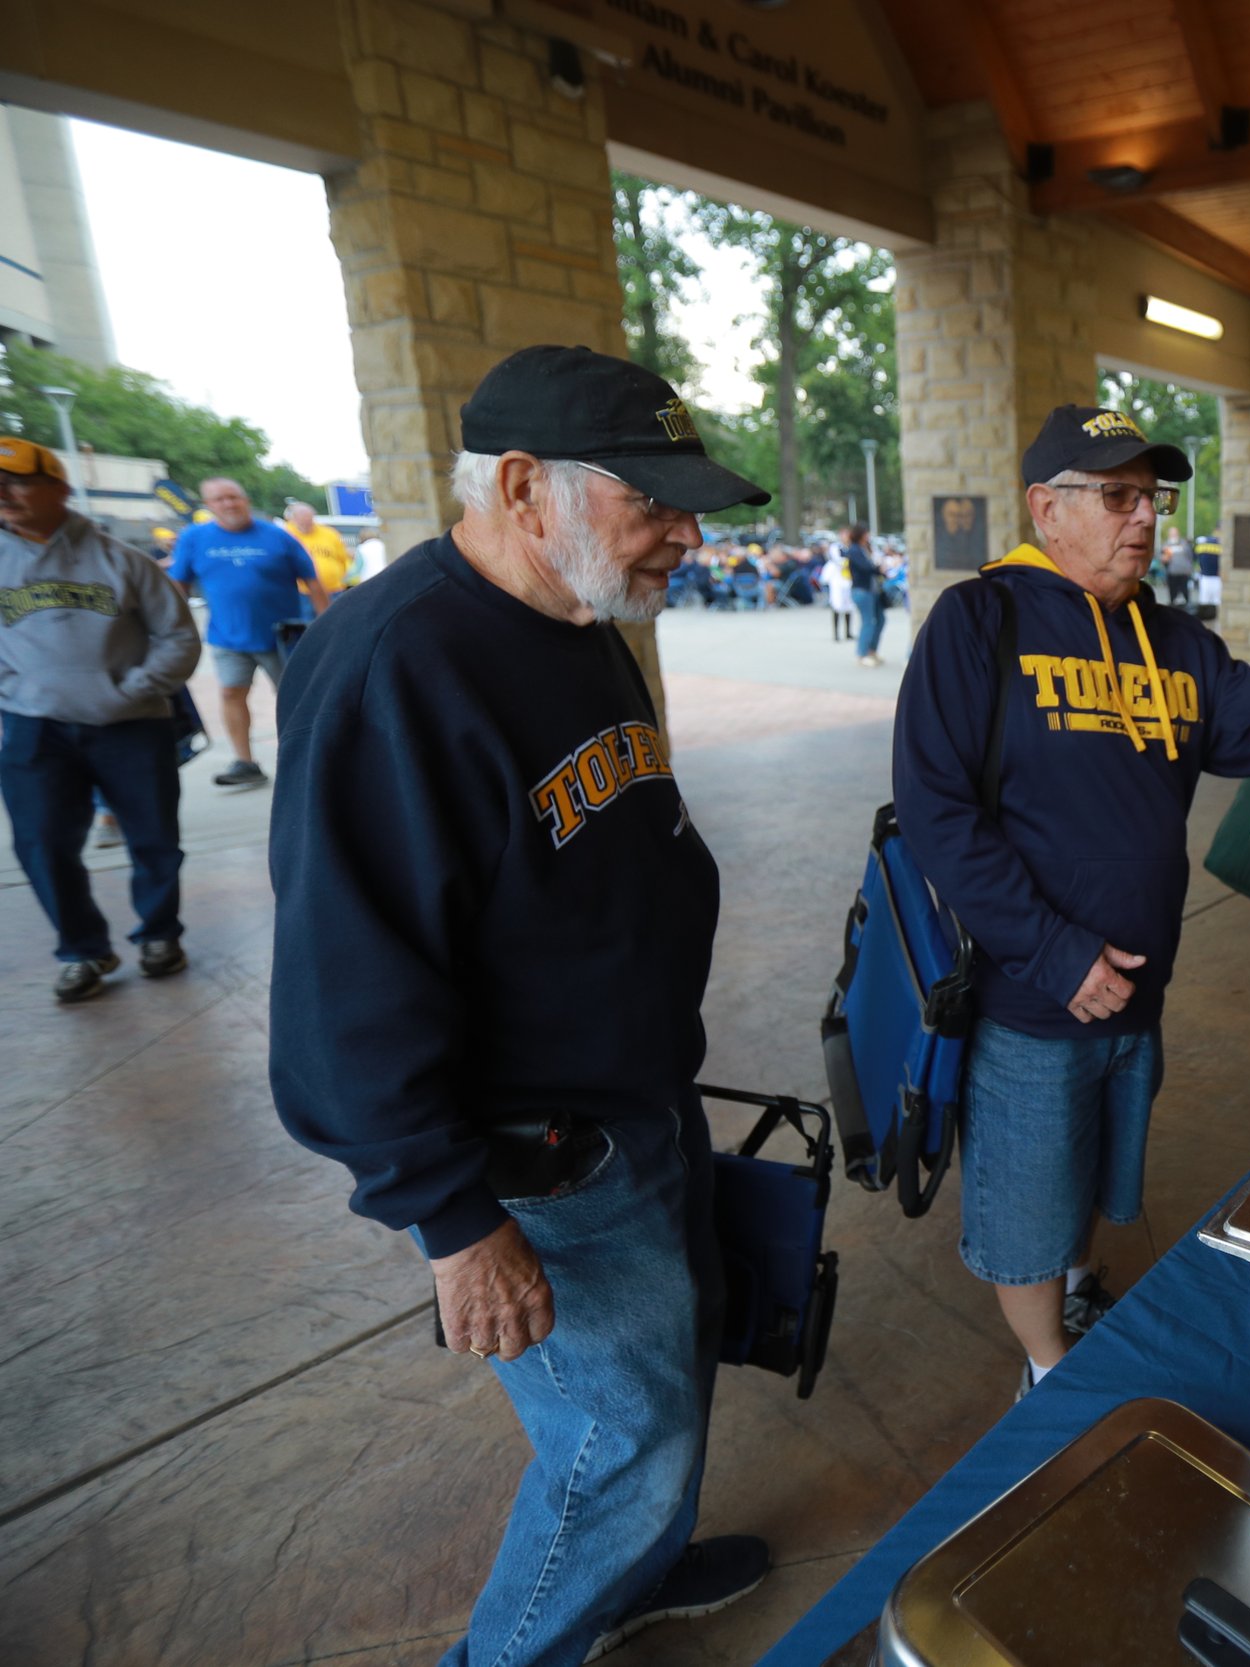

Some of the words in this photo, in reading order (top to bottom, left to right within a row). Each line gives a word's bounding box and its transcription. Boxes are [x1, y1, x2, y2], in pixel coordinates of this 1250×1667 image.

[696, 18, 720, 53] &
[727, 32, 799, 87] Carol
[641, 43, 747, 108] Alumni
[751, 86, 847, 147] Pavilion
[1081, 411, 1149, 443] TOL
[1019, 654, 1200, 722] TOLEDO
[528, 720, 674, 850] TOLE
